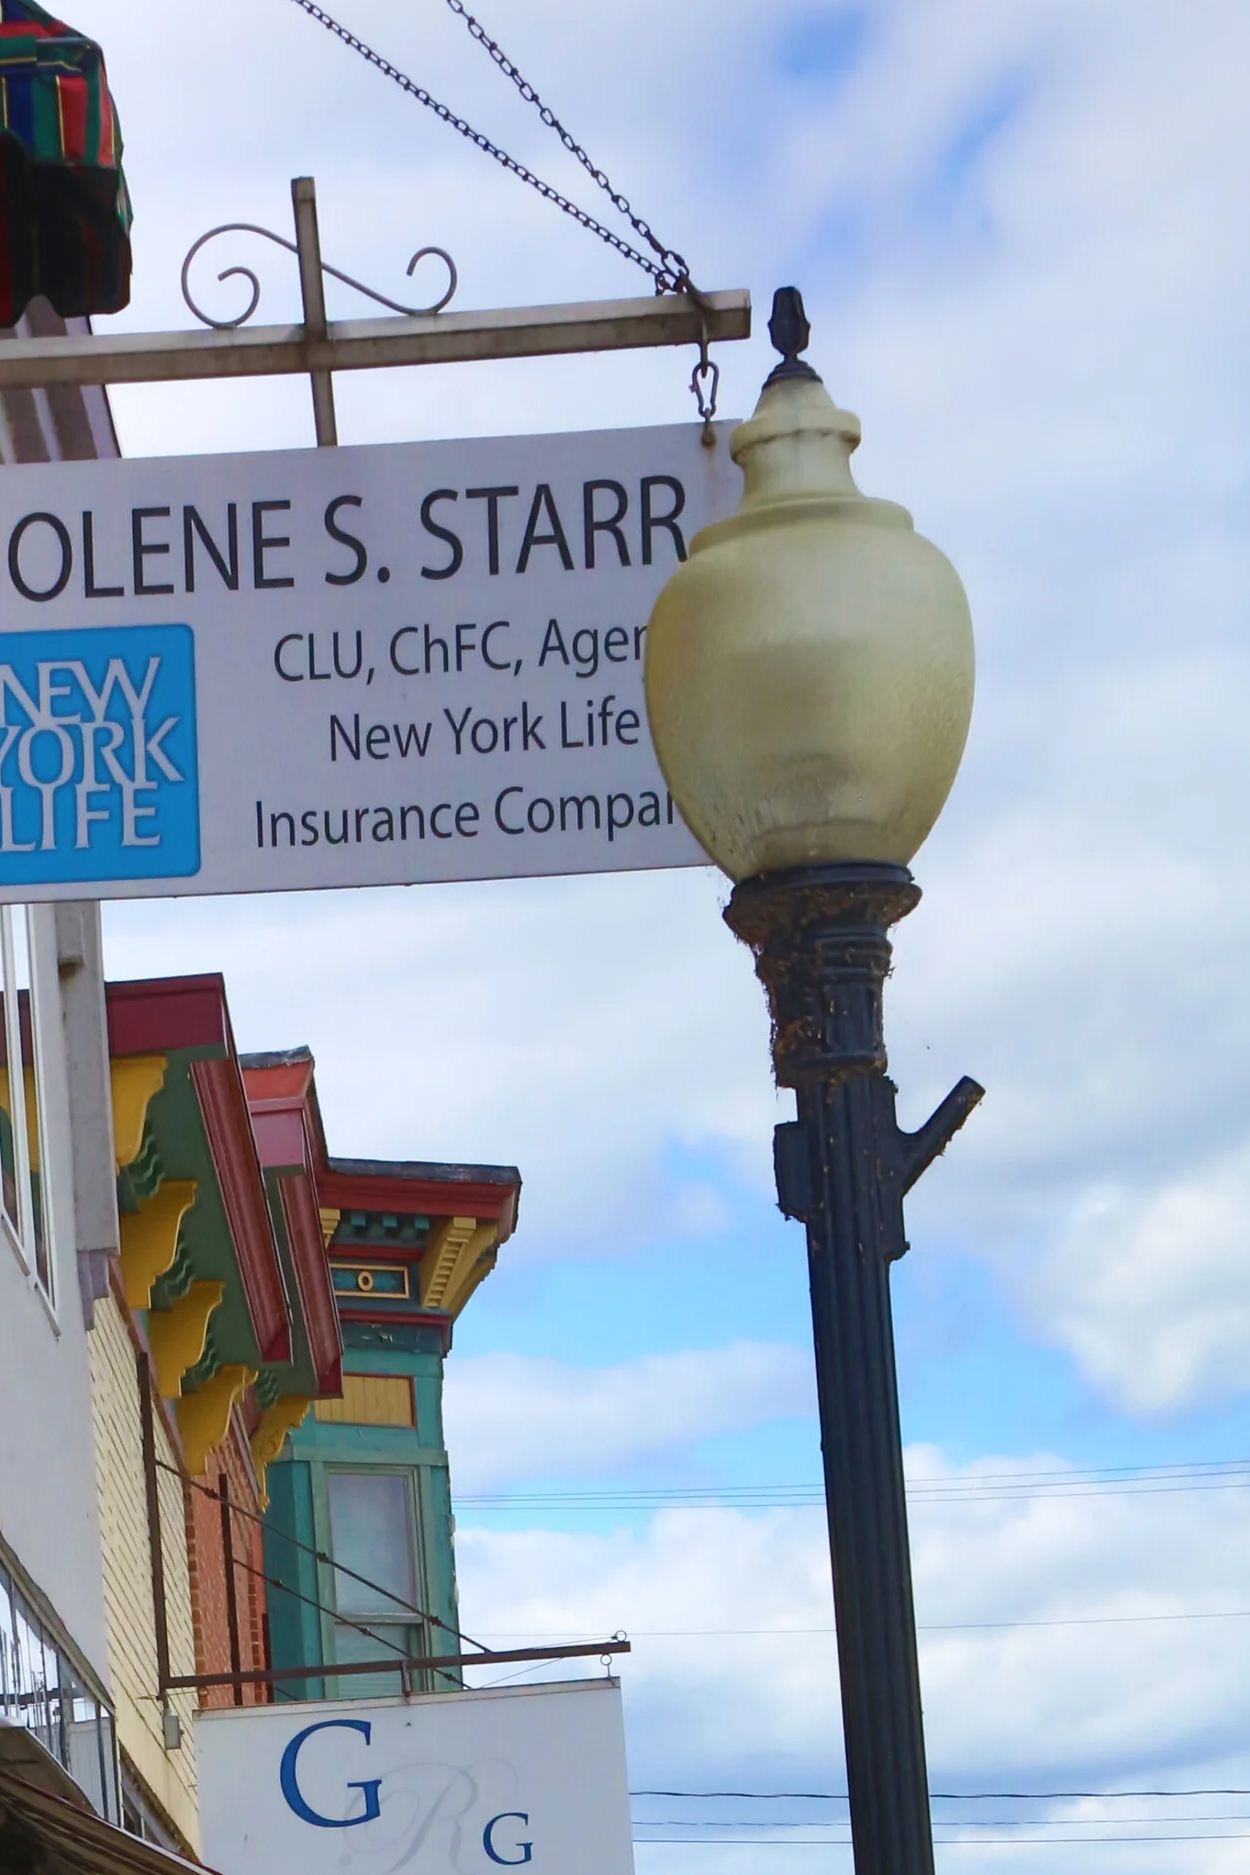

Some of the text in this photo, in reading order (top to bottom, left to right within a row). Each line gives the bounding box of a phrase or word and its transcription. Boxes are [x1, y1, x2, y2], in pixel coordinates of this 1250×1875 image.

[324, 494, 391, 587] S.
[420, 474, 688, 581] STARR
[273, 630, 375, 685] CLU,
[389, 620, 523, 677] ChFC,
[329, 695, 641, 762] New York Life
[0, 784, 161, 852] LIFE
[255, 800, 480, 849] Insurance
[279, 1718, 383, 1829] G
[482, 1811, 534, 1866] G
